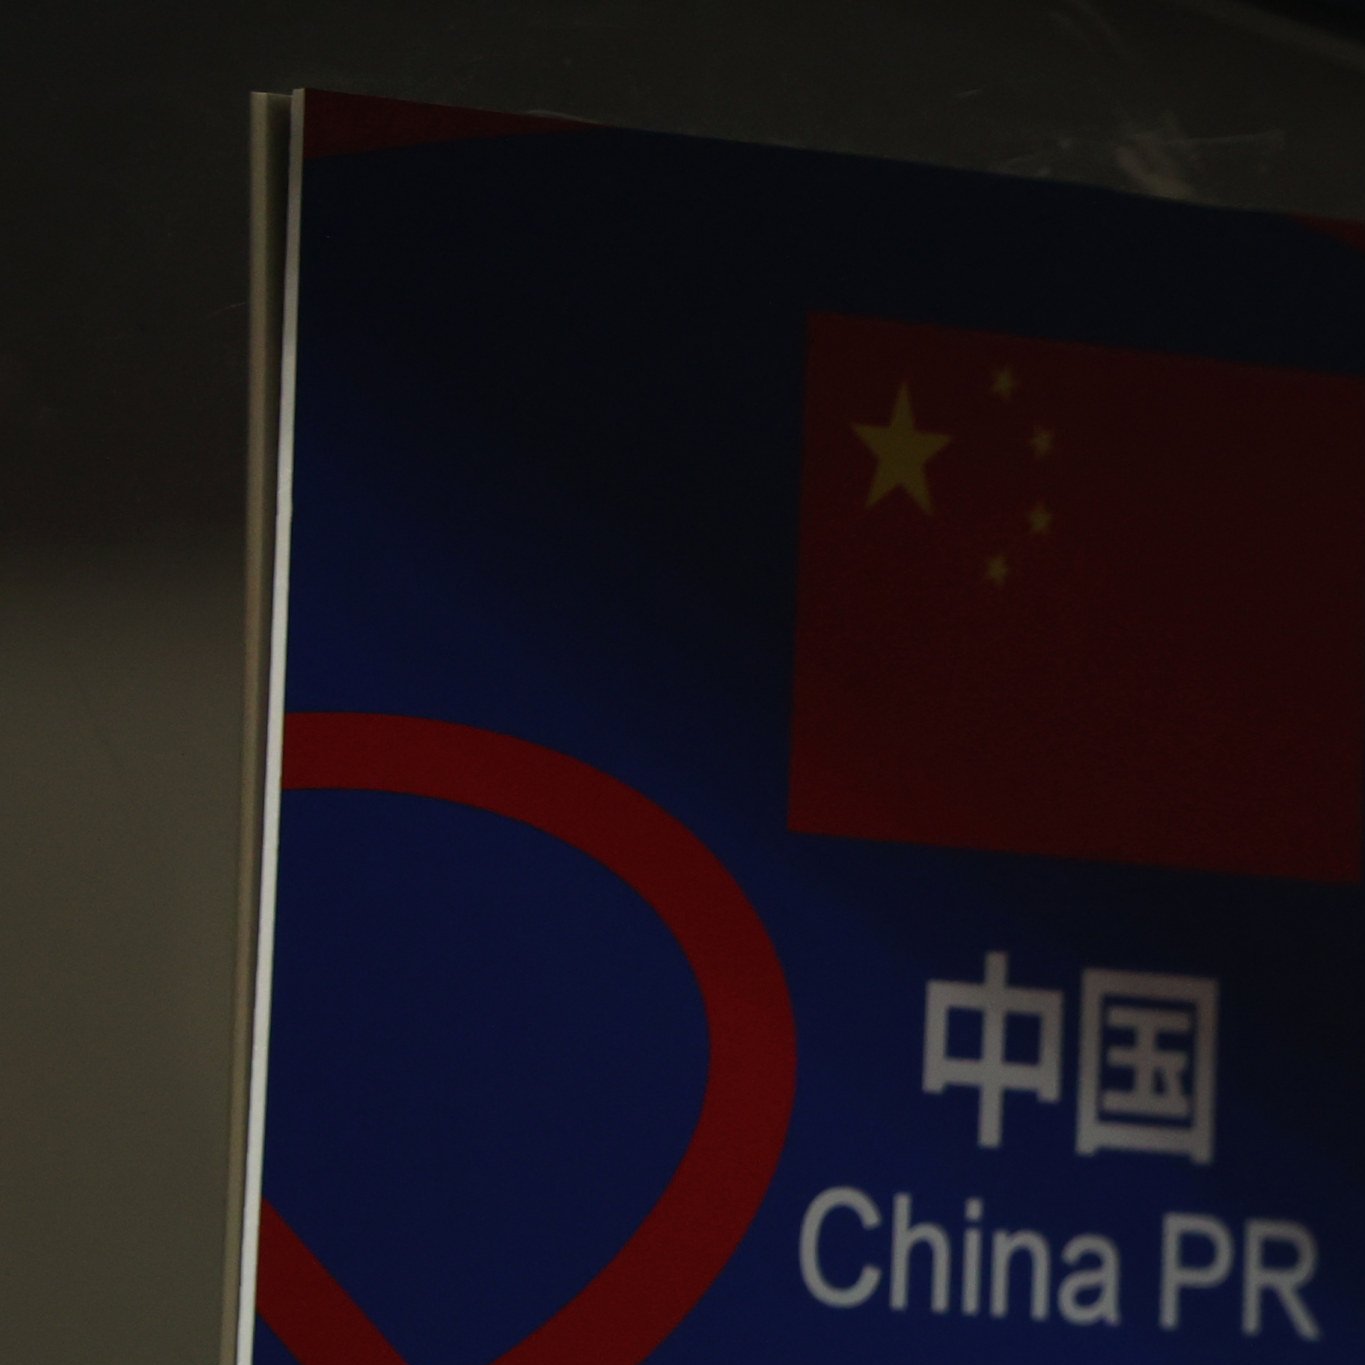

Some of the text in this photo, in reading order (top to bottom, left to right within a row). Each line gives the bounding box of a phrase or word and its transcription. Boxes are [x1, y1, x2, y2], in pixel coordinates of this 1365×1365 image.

[920, 951, 1219, 1165] 中国
[798, 1185, 1323, 1342] China PR
